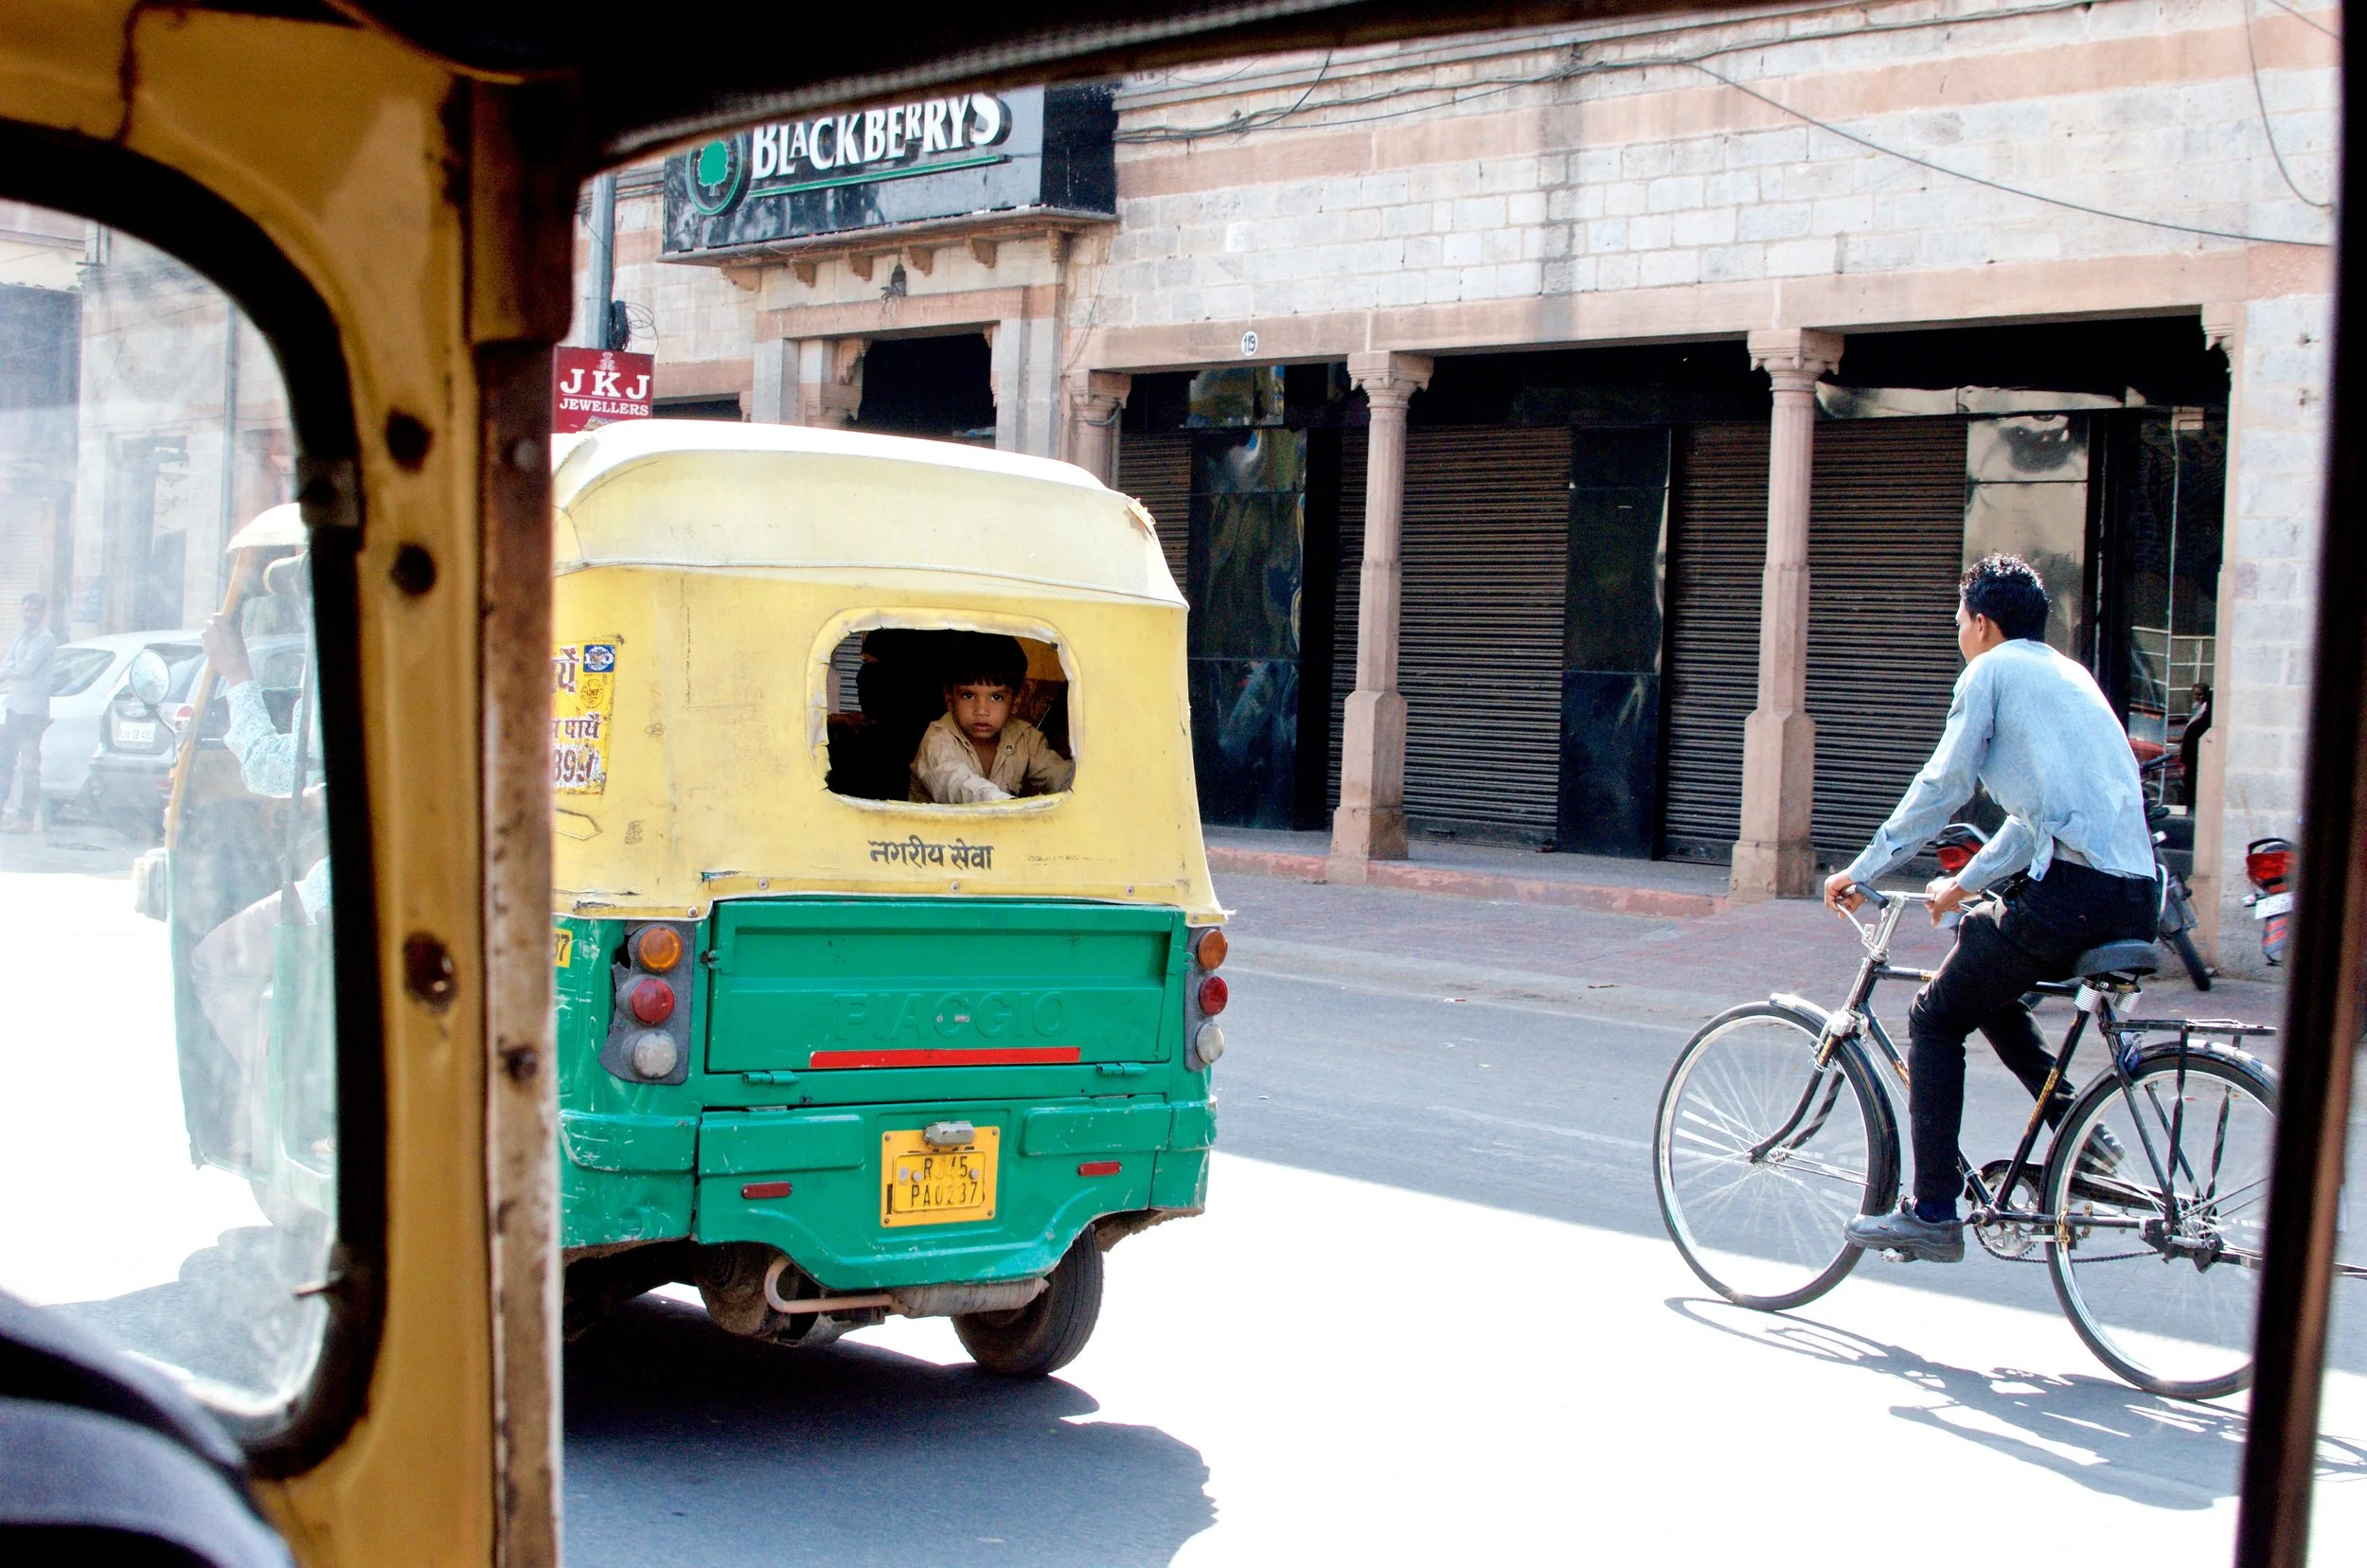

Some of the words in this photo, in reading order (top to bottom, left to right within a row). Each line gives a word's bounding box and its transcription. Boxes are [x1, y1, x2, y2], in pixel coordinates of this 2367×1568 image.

[752, 92, 1001, 180] BLACKBERRYS
[559, 398, 650, 416] JEWELLERS
[868, 834, 945, 868] नगरीय
[947, 838, 994, 870] सेवा
[832, 990, 1073, 1041] PIAGGIO
